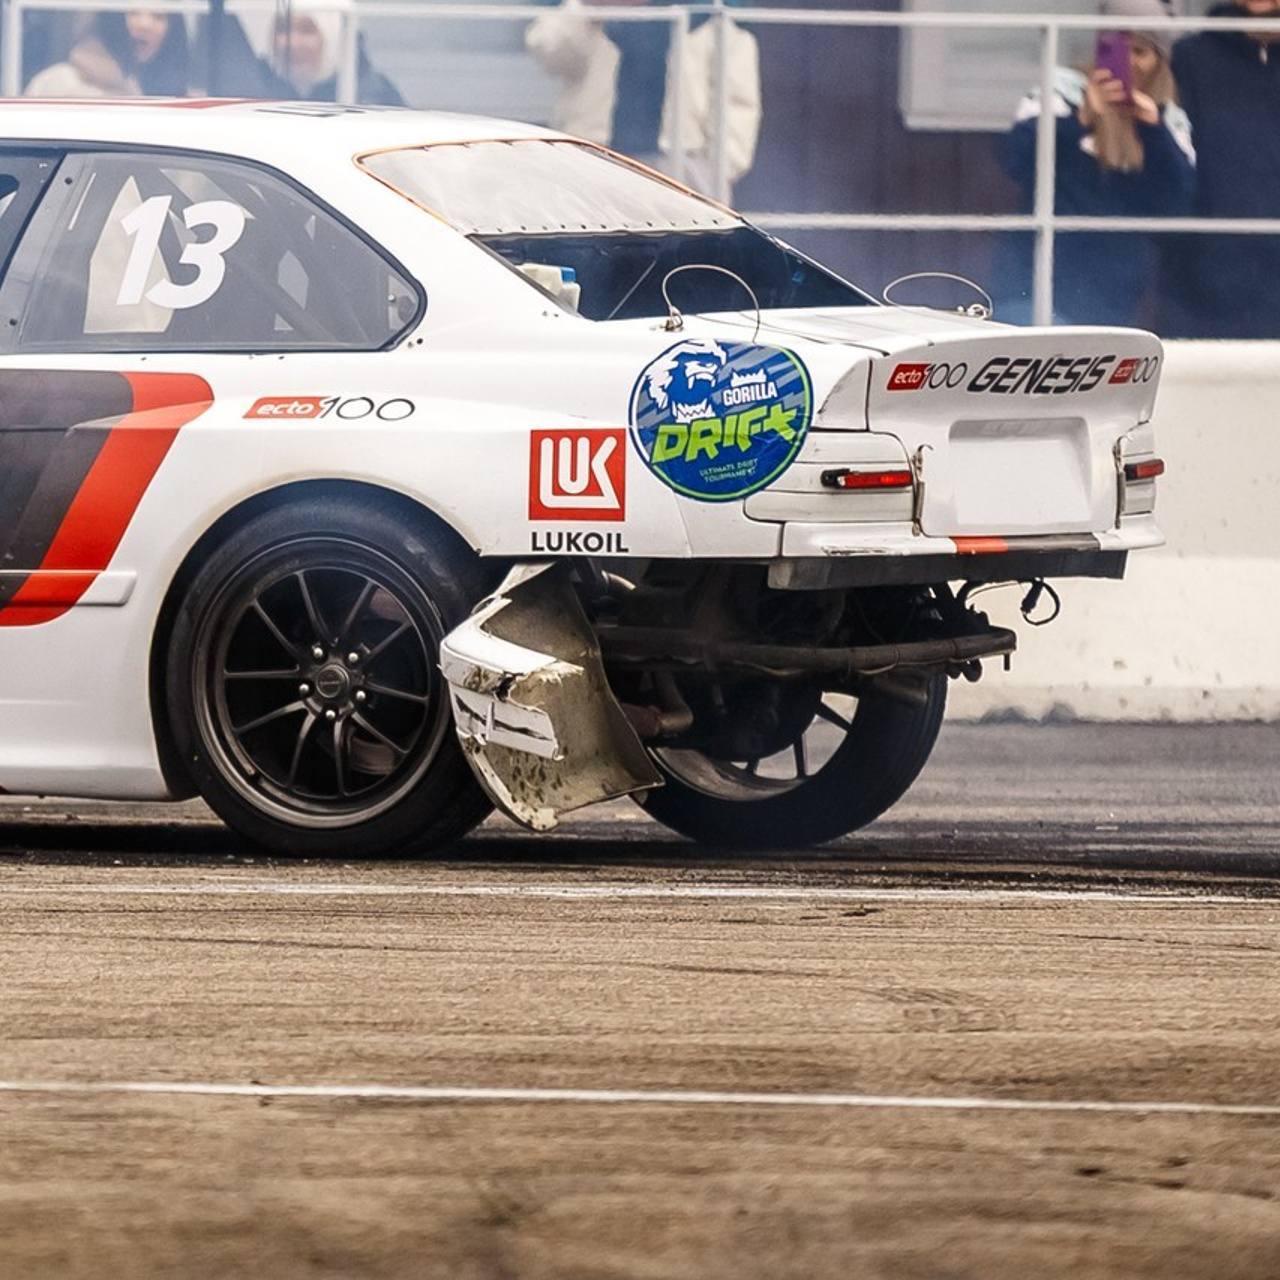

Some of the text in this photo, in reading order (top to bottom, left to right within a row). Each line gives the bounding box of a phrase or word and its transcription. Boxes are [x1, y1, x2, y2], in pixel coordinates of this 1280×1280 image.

[116, 195, 246, 310] 13
[966, 354, 1117, 394] GENESIS
[723, 381, 778, 407] GORILLA
[530, 531, 629, 553] LUKOIL
